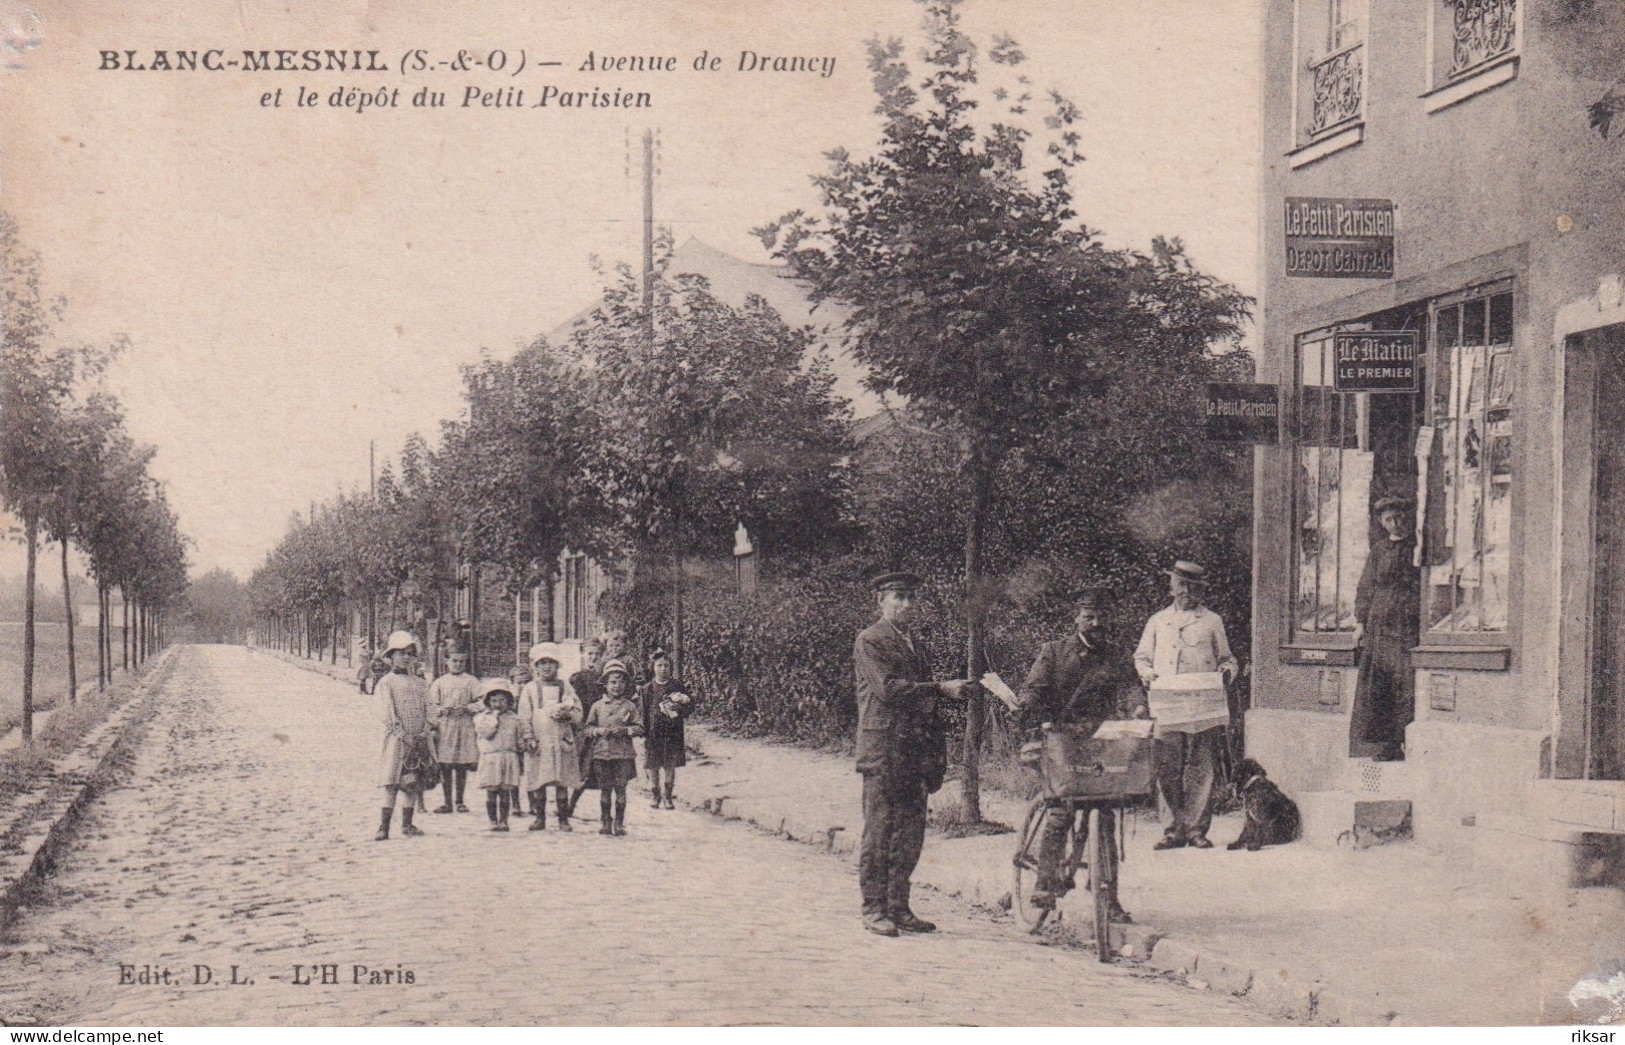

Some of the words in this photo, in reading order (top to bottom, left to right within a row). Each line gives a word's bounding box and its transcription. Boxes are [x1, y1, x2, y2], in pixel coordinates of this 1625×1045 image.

[1286, 203, 1300, 235] Le
[1301, 203, 1333, 235] Petit
[1335, 203, 1393, 236] Parisien
[1334, 248, 1393, 273] CENTRAL
[1338, 338, 1359, 363] Le
[1360, 338, 1412, 362] Matin
[1340, 368, 1355, 379] LE
[1358, 367, 1412, 379] PREMIER
[1205, 398, 1216, 416] Le
[1217, 398, 1240, 417] Petit
[1240, 397, 1277, 418] Parisien
